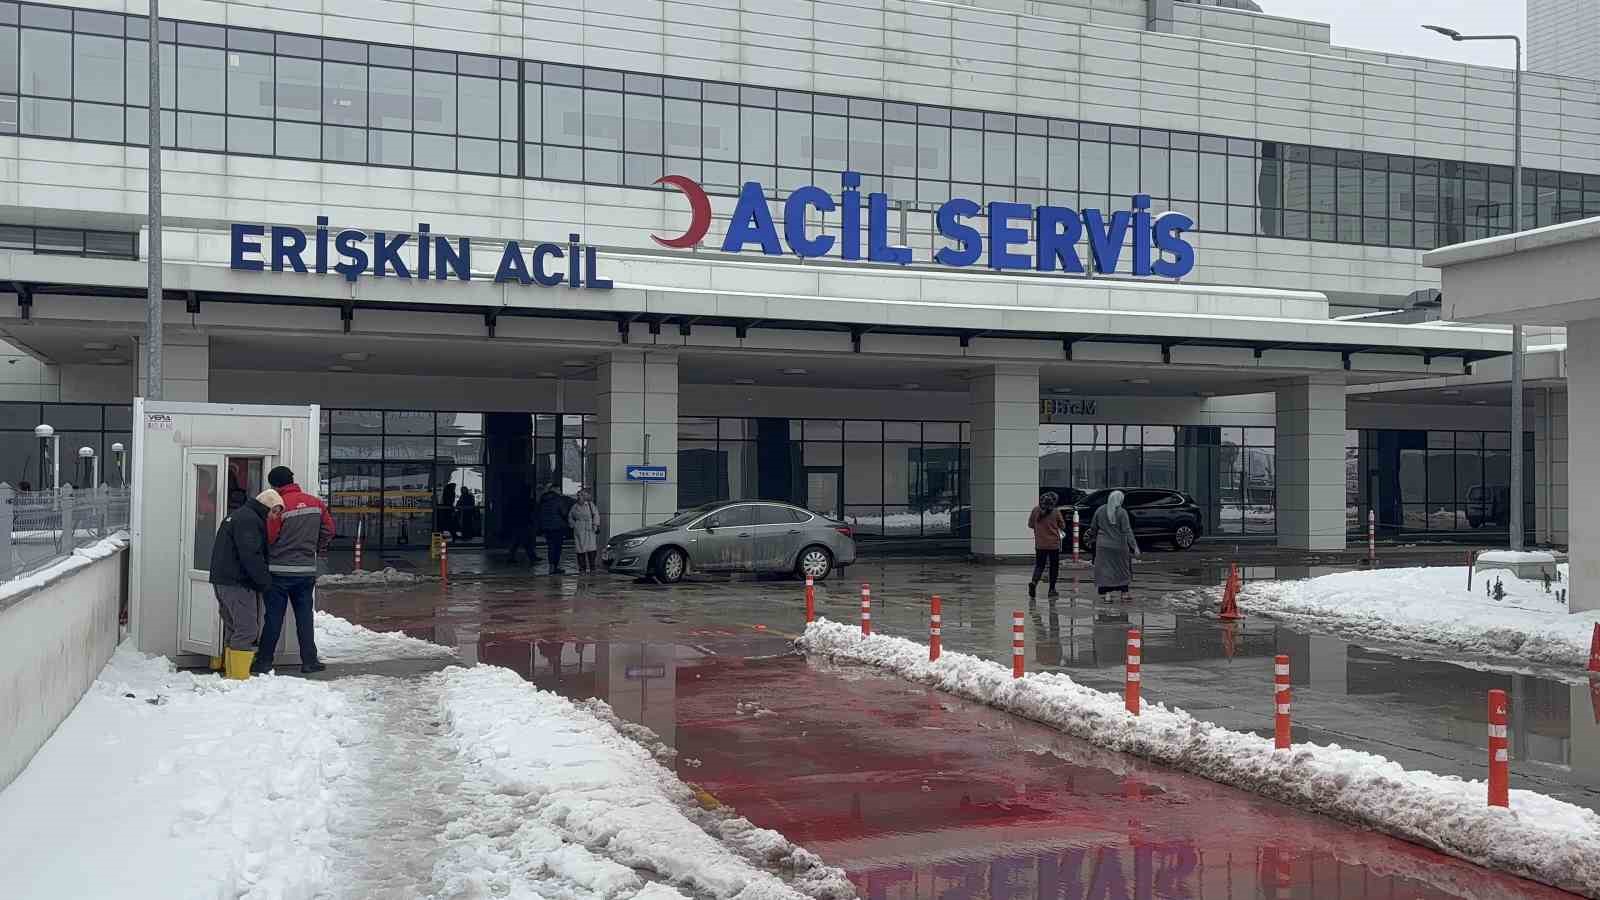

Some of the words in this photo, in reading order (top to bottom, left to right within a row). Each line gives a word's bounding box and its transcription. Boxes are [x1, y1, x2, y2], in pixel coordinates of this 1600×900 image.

[231, 216, 471, 281] ERİŞKİN
[495, 233, 613, 289] ACİL
[721, 171, 912, 265] ACİL
[935, 194, 1195, 279] SERVİS
